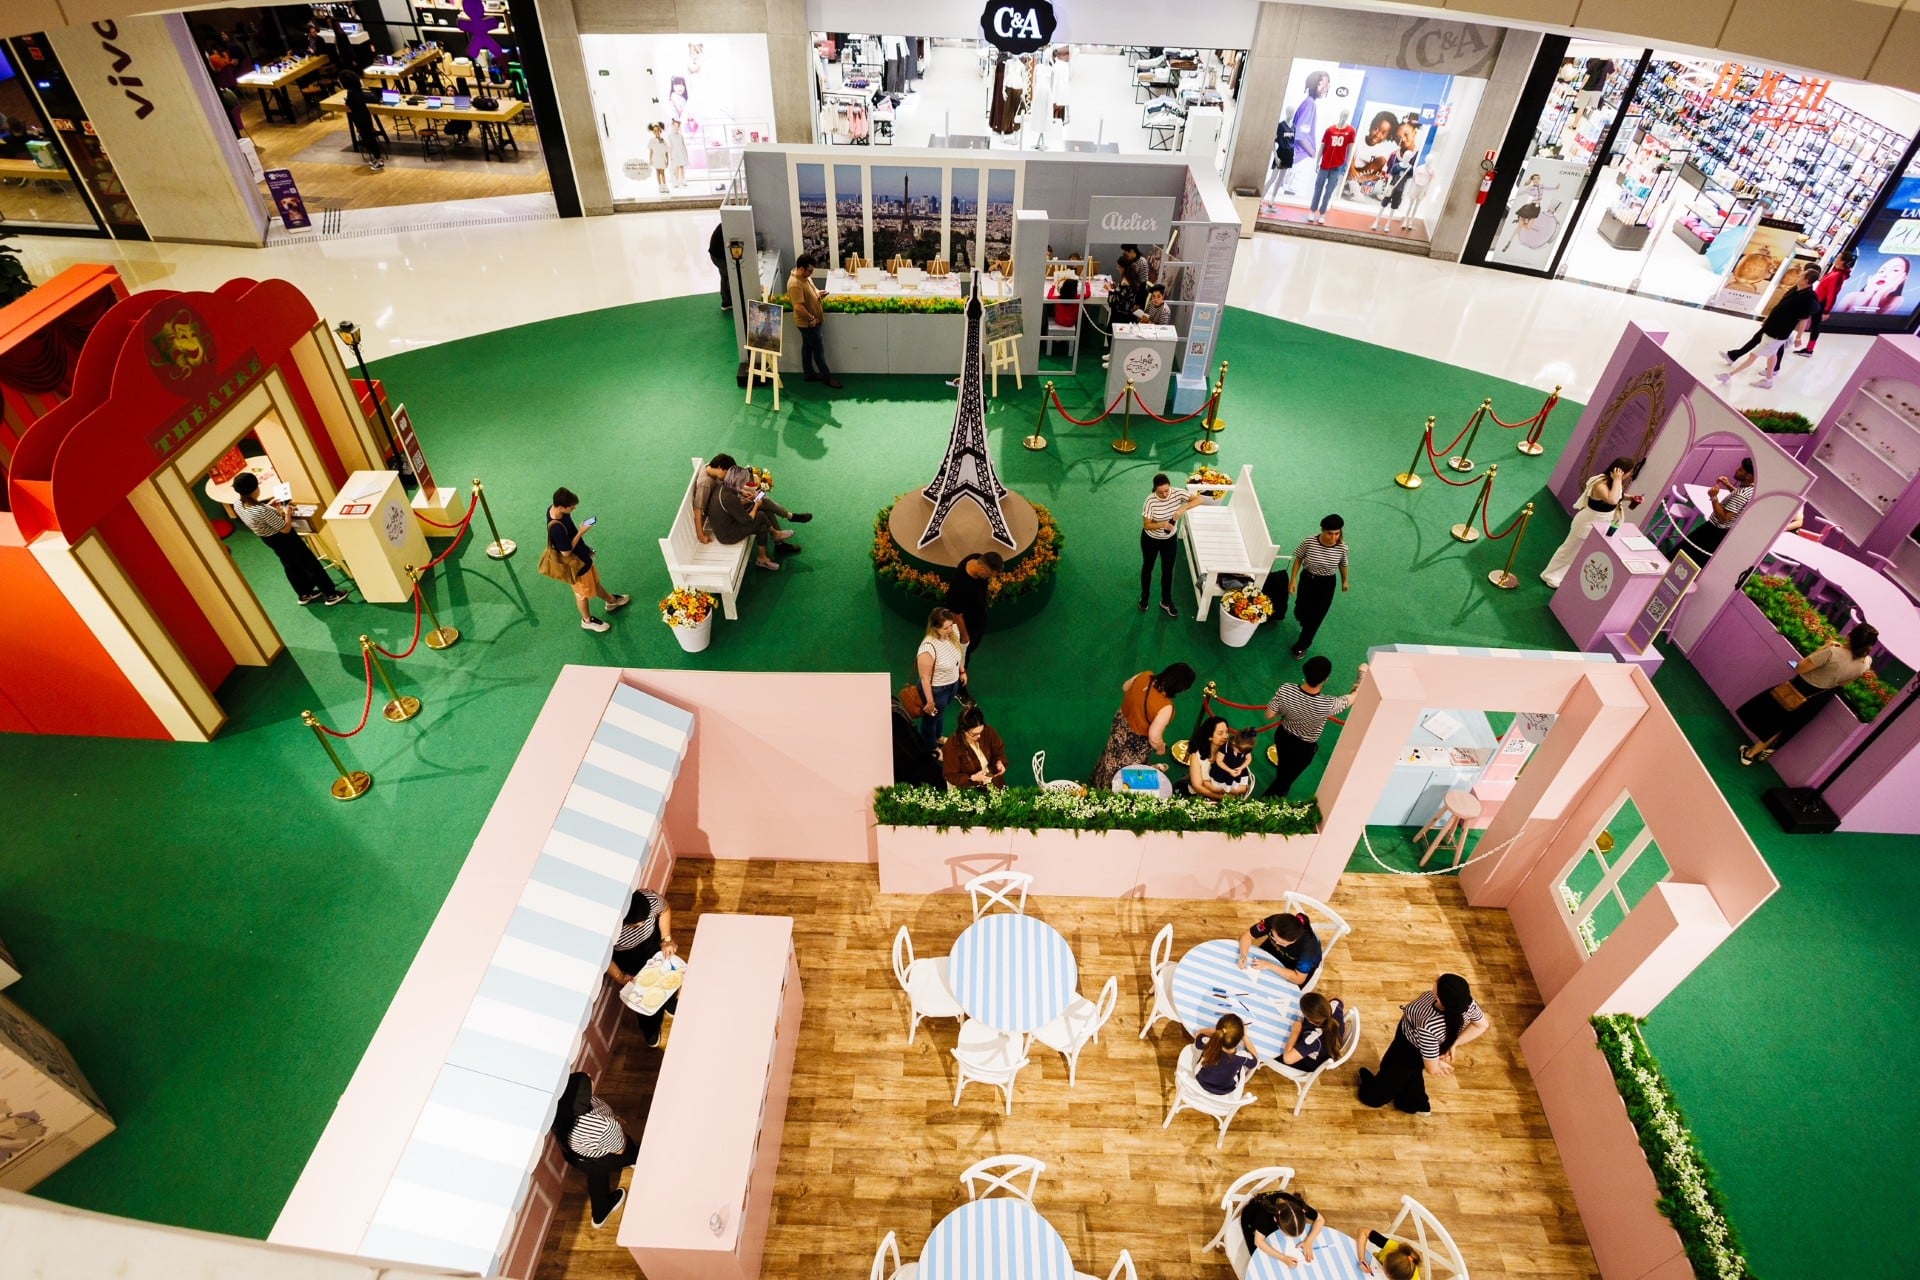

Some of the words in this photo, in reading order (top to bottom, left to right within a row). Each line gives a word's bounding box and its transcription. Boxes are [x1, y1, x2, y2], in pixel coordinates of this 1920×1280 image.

[993, 6, 1043, 39] C&A
[1415, 23, 1488, 68] C&A
[1101, 211, 1159, 231] Atelier
[155, 356, 262, 454] THÉÂTRE
